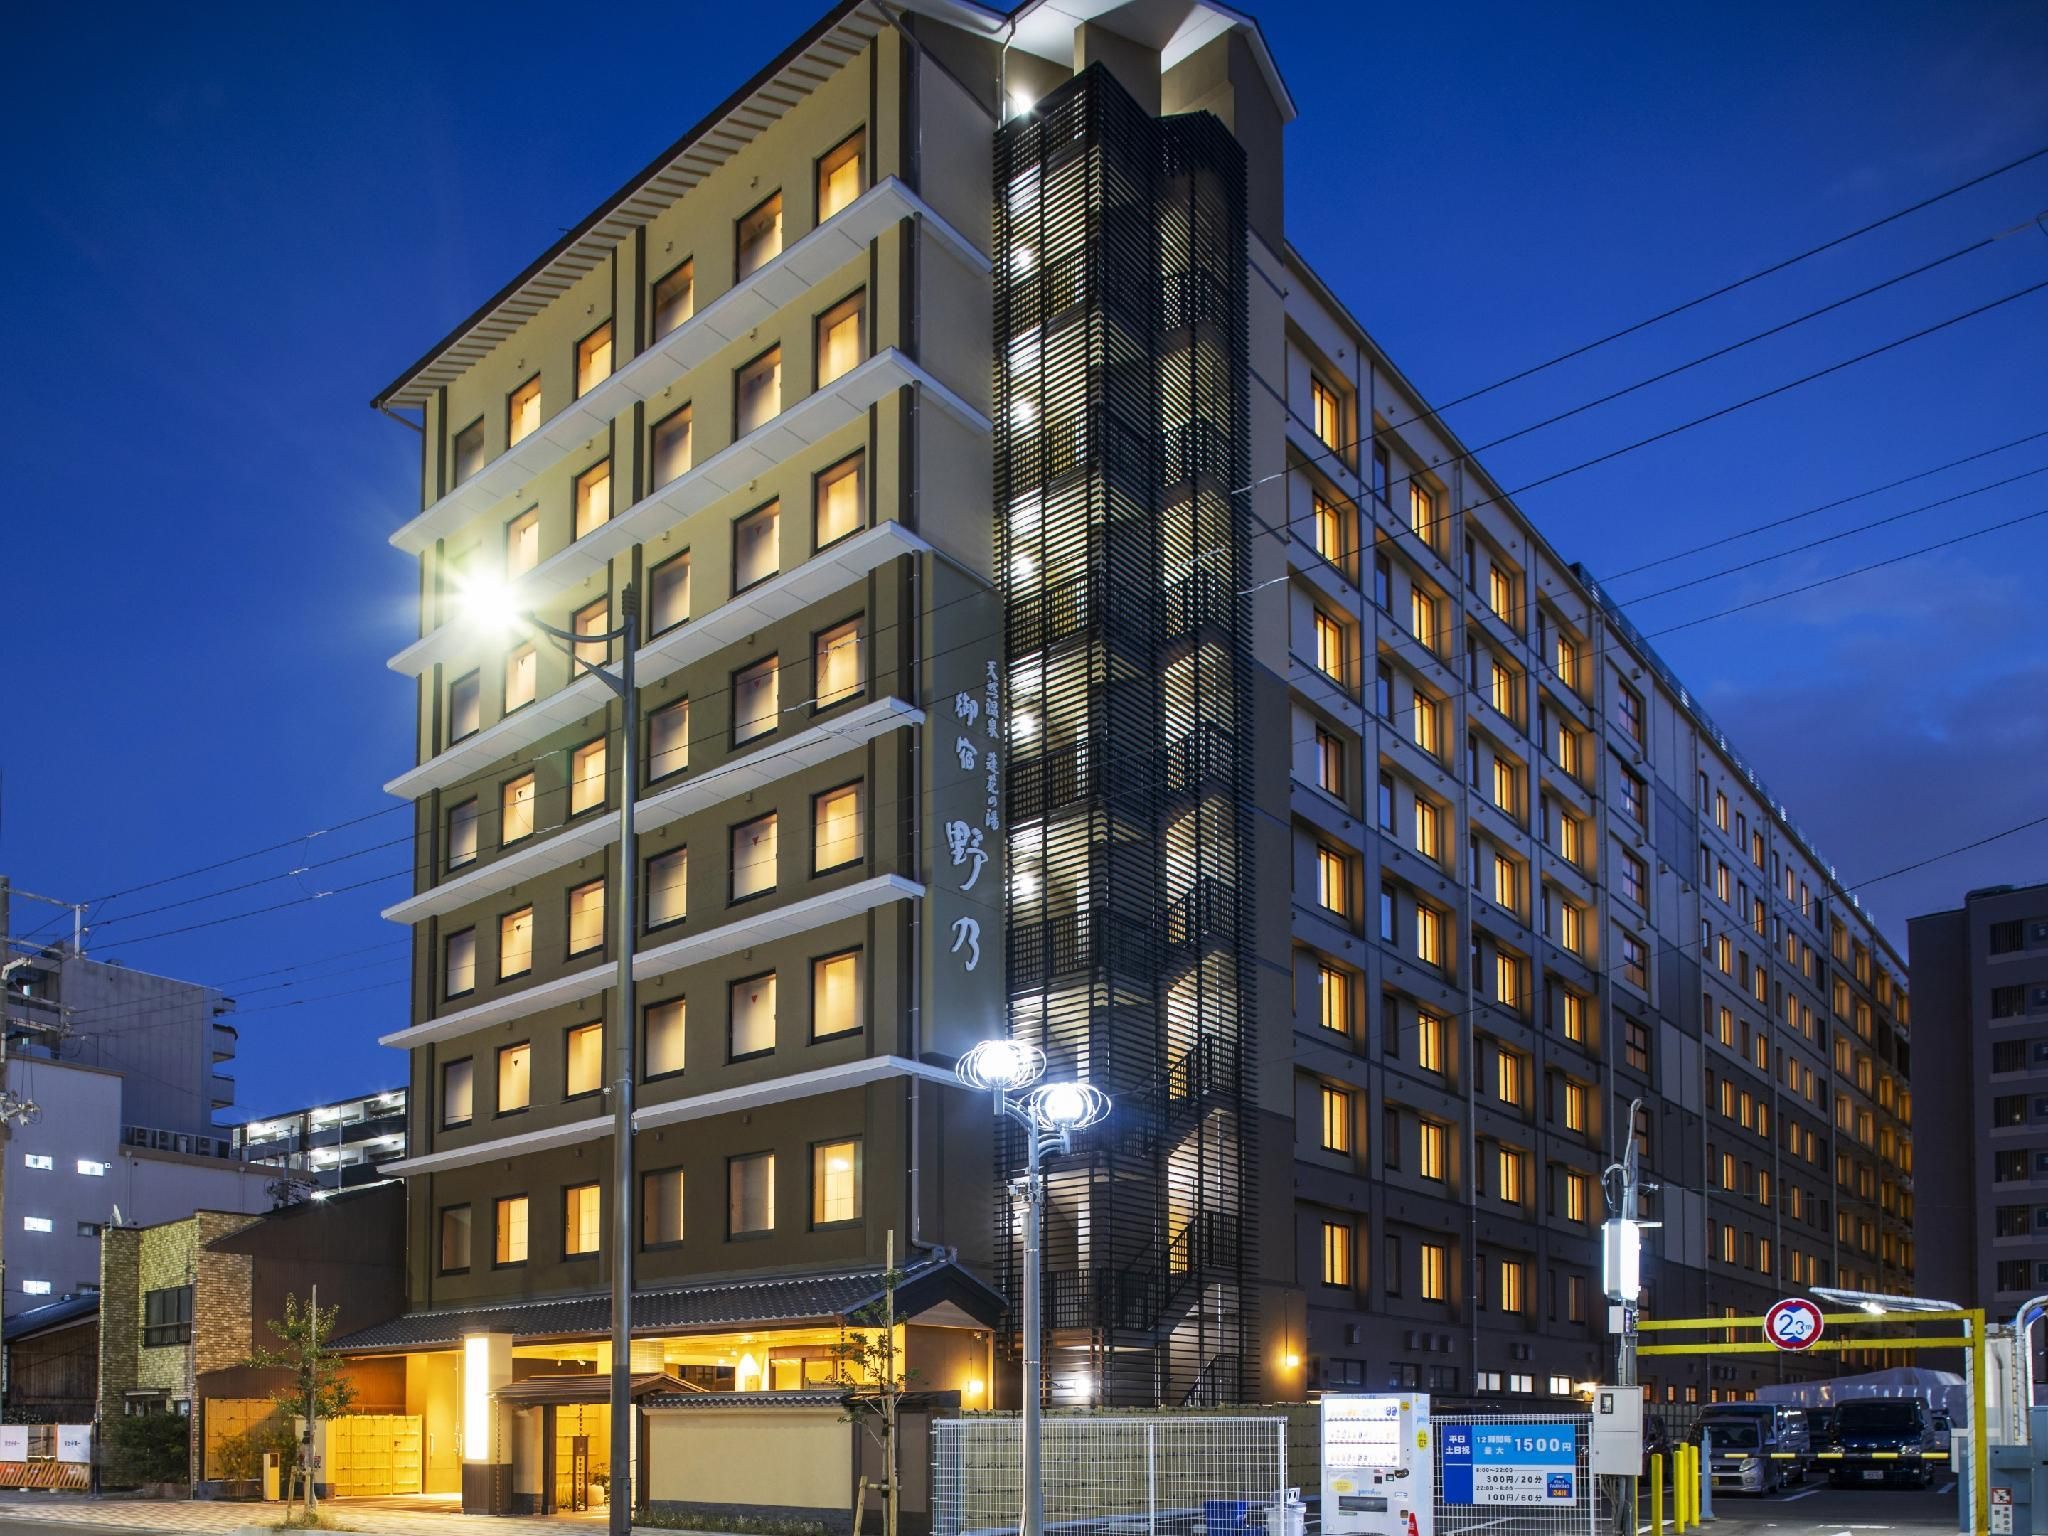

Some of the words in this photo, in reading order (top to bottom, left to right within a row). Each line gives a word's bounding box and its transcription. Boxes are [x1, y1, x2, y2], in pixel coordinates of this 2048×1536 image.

[944, 820, 989, 973] 野乃
[1448, 1435, 1466, 1444] 平日
[1445, 1446, 1471, 1455] 土日祝
